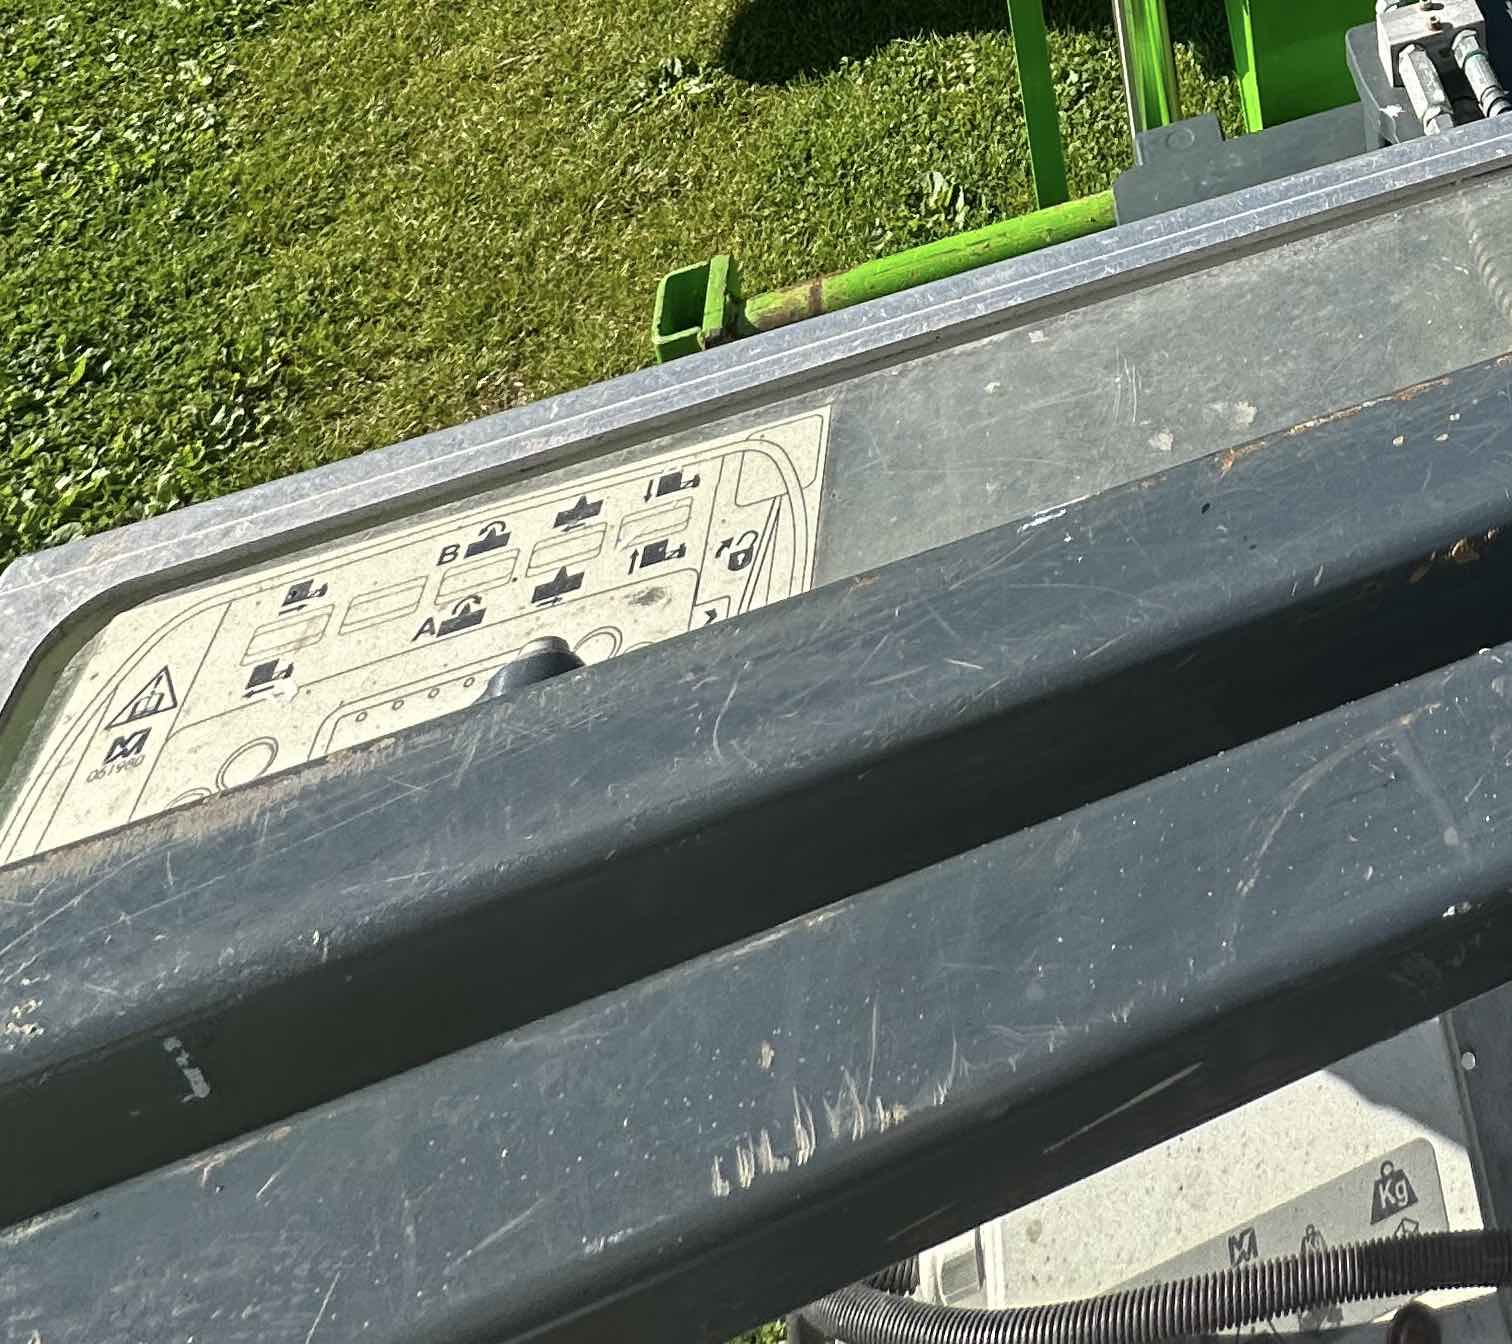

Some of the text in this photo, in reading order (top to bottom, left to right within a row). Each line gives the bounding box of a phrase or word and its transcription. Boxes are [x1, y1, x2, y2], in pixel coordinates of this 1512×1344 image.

[436, 543, 460, 566] B
[411, 616, 436, 642] A
[1379, 1178, 1408, 1209] Kg
